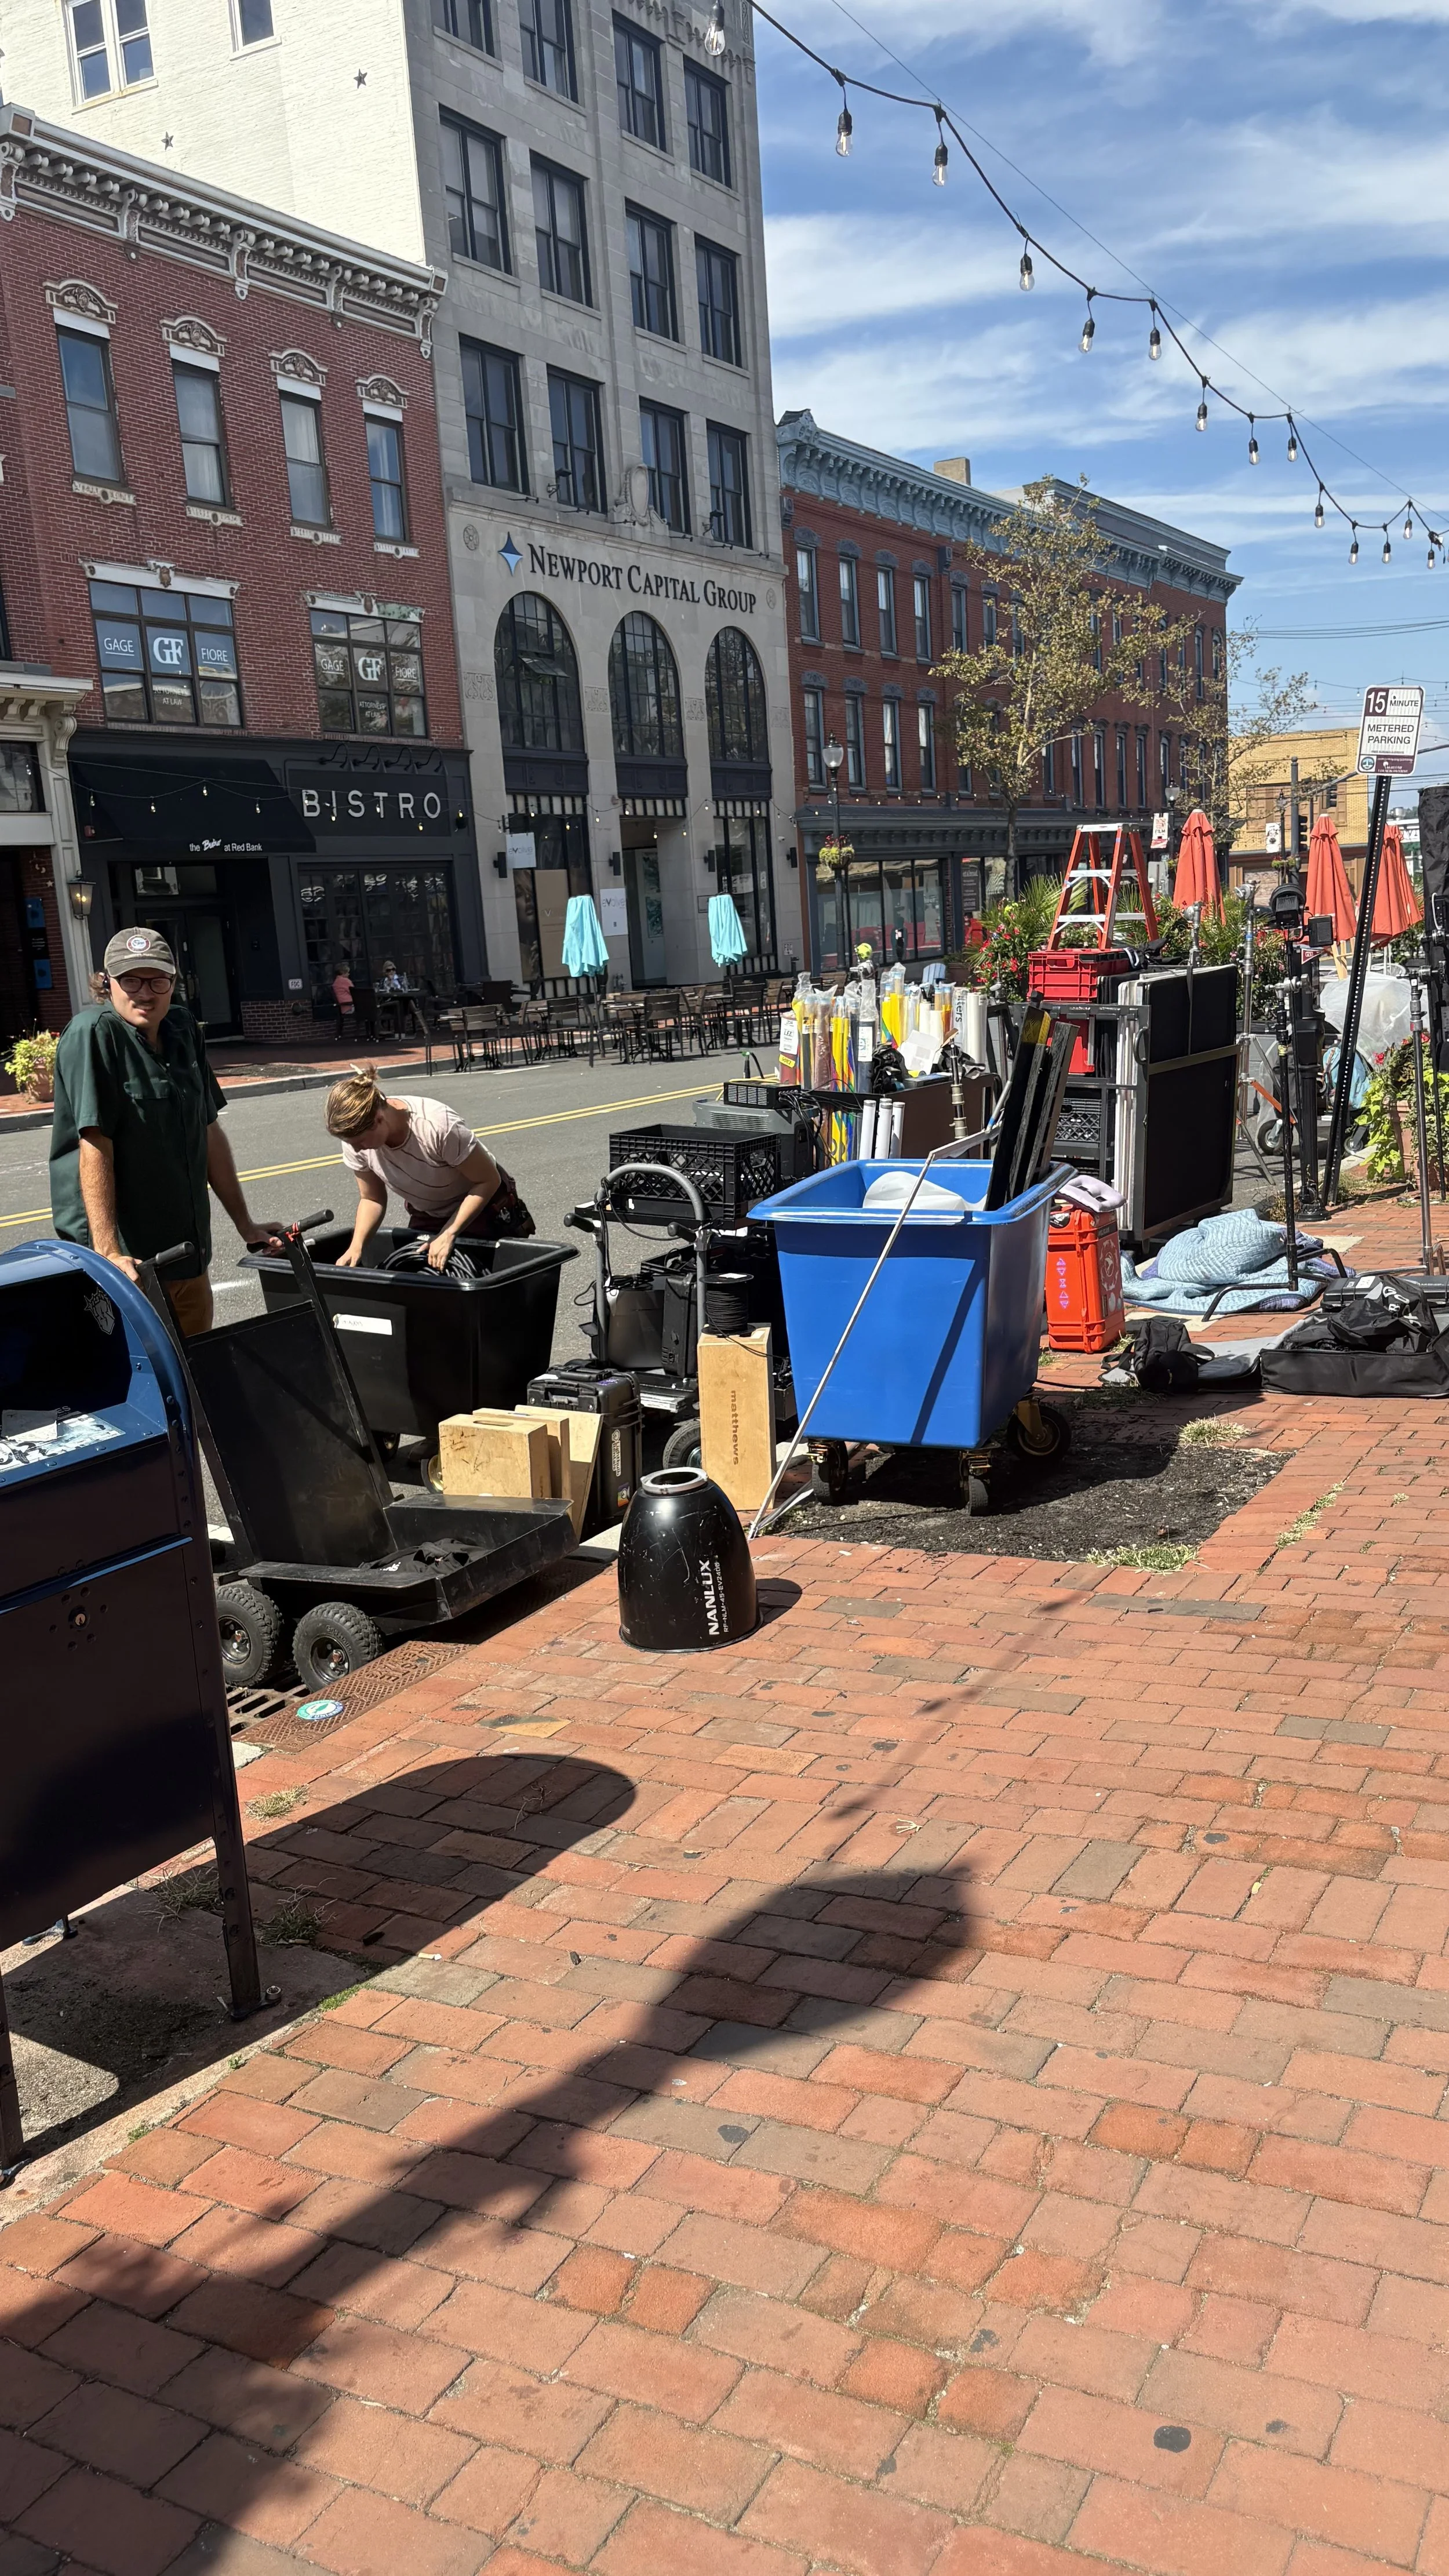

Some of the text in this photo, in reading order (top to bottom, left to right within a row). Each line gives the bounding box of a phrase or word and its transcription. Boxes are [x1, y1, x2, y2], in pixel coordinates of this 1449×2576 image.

[104, 638, 134, 653] GAGE
[153, 637, 184, 665] GF
[201, 648, 229, 662] FIORE
[321, 658, 344, 671] GAGE
[358, 657, 383, 681] GF
[395, 667, 417, 679] FIORE
[1367, 692, 1386, 714] 15
[1367, 724, 1414, 733] METERED
[1367, 736, 1411, 744] PARKING
[302, 789, 441, 818] BISTRO
[189, 843, 201, 852] the
[231, 843, 245, 852] Red
[246, 843, 263, 852] Bank
[731, 1390, 739, 1465] matthews
[699, 1560, 720, 1635] NANLUX
